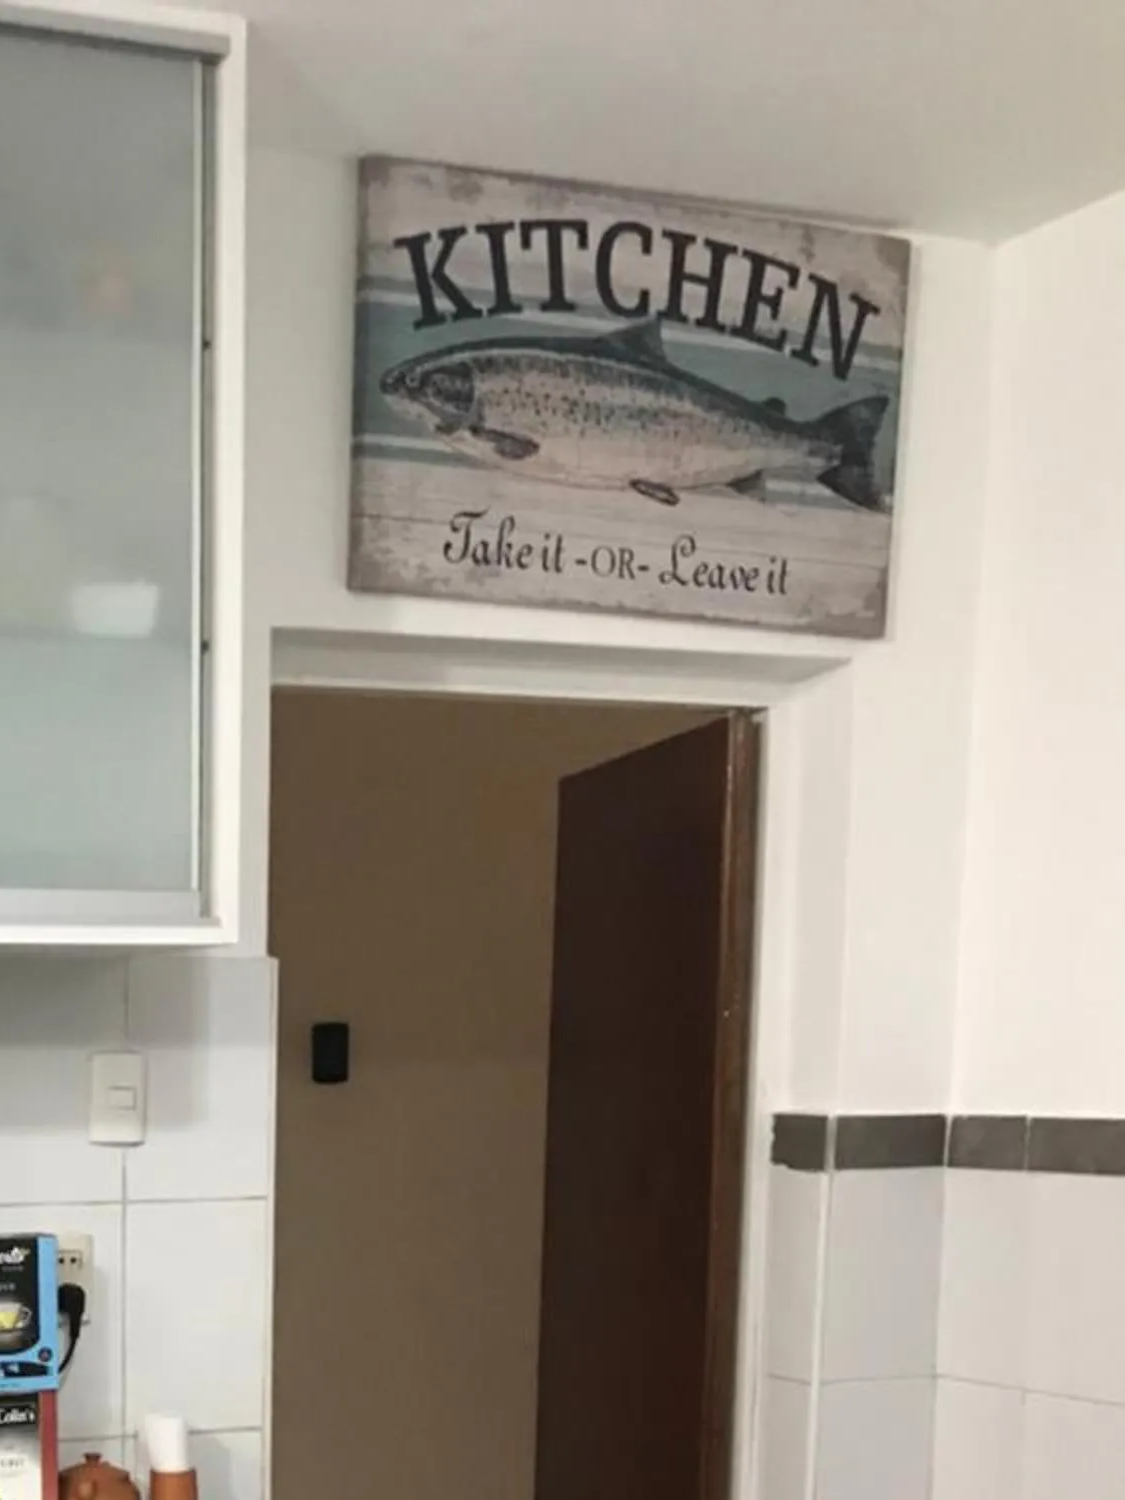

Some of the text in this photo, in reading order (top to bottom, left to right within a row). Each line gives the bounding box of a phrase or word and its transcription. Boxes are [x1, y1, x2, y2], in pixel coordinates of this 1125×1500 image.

[393, 218, 880, 381] KITCHEN
[443, 508, 533, 570] Take
[541, 532, 564, 574] it
[658, 534, 759, 593] Leave
[765, 557, 789, 596] it
